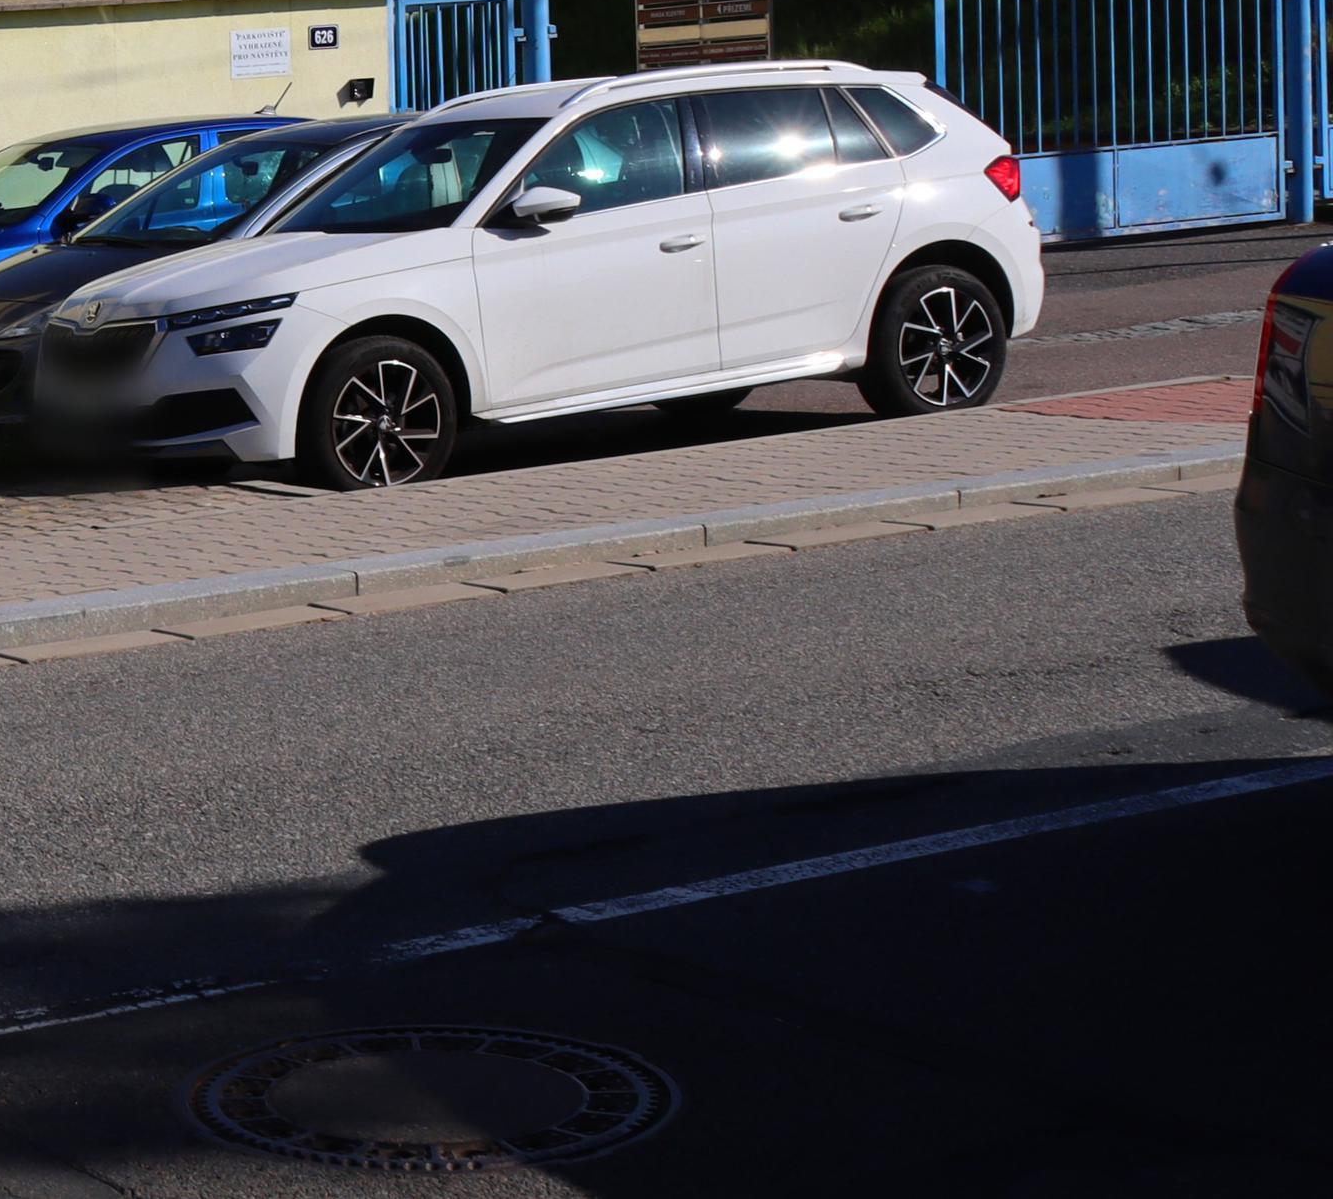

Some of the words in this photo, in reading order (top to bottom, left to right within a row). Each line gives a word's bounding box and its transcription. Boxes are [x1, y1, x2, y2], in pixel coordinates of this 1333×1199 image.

[235, 30, 286, 41] PARKOVIŠTĚ
[314, 29, 333, 44] 626
[238, 40, 282, 50] VYHRAZENÉ
